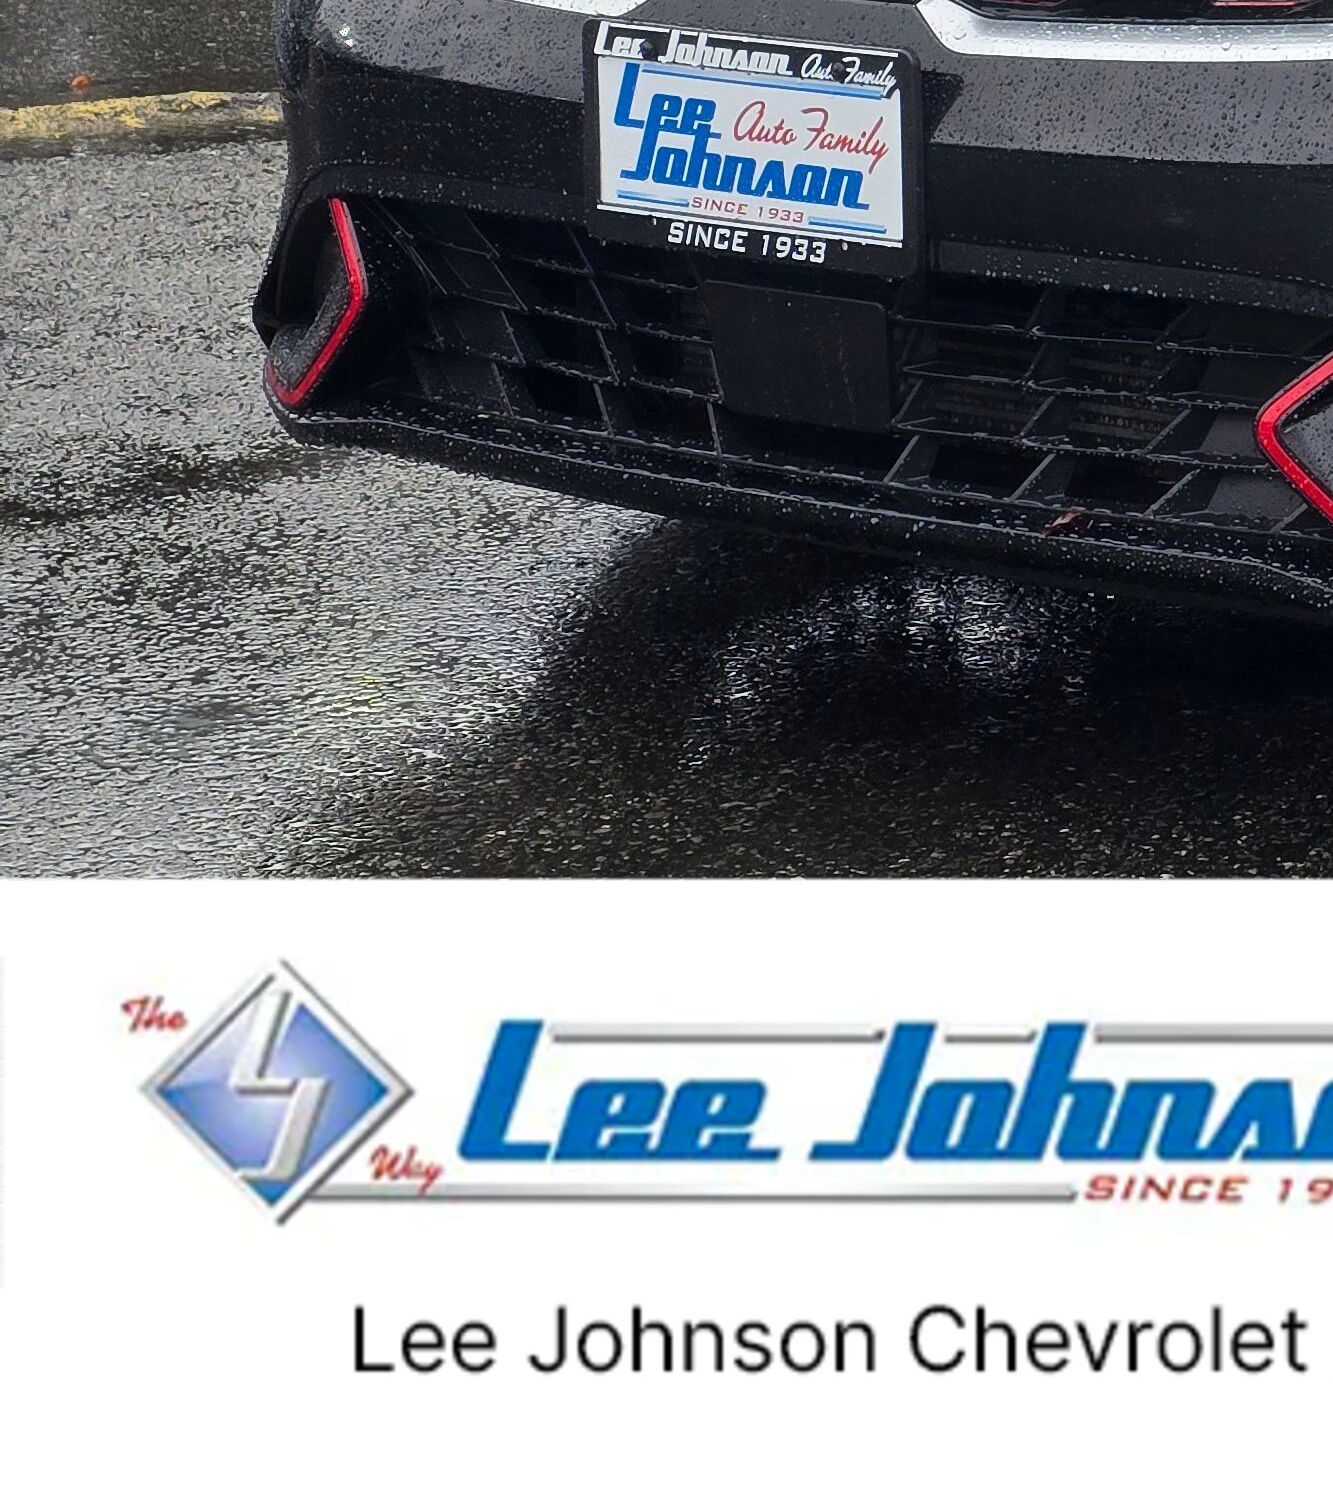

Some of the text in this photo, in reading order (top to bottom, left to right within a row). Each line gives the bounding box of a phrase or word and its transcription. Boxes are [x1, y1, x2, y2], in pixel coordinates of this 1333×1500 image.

[657, 29, 793, 76] Johnson
[801, 53, 842, 81] Aut
[841, 56, 898, 97] Family
[614, 62, 722, 140] Lee
[620, 125, 870, 211] Johnson
[733, 100, 890, 175] Auto Family
[667, 221, 827, 264] SINCE 1933
[691, 196, 805, 223] SINCE 1933
